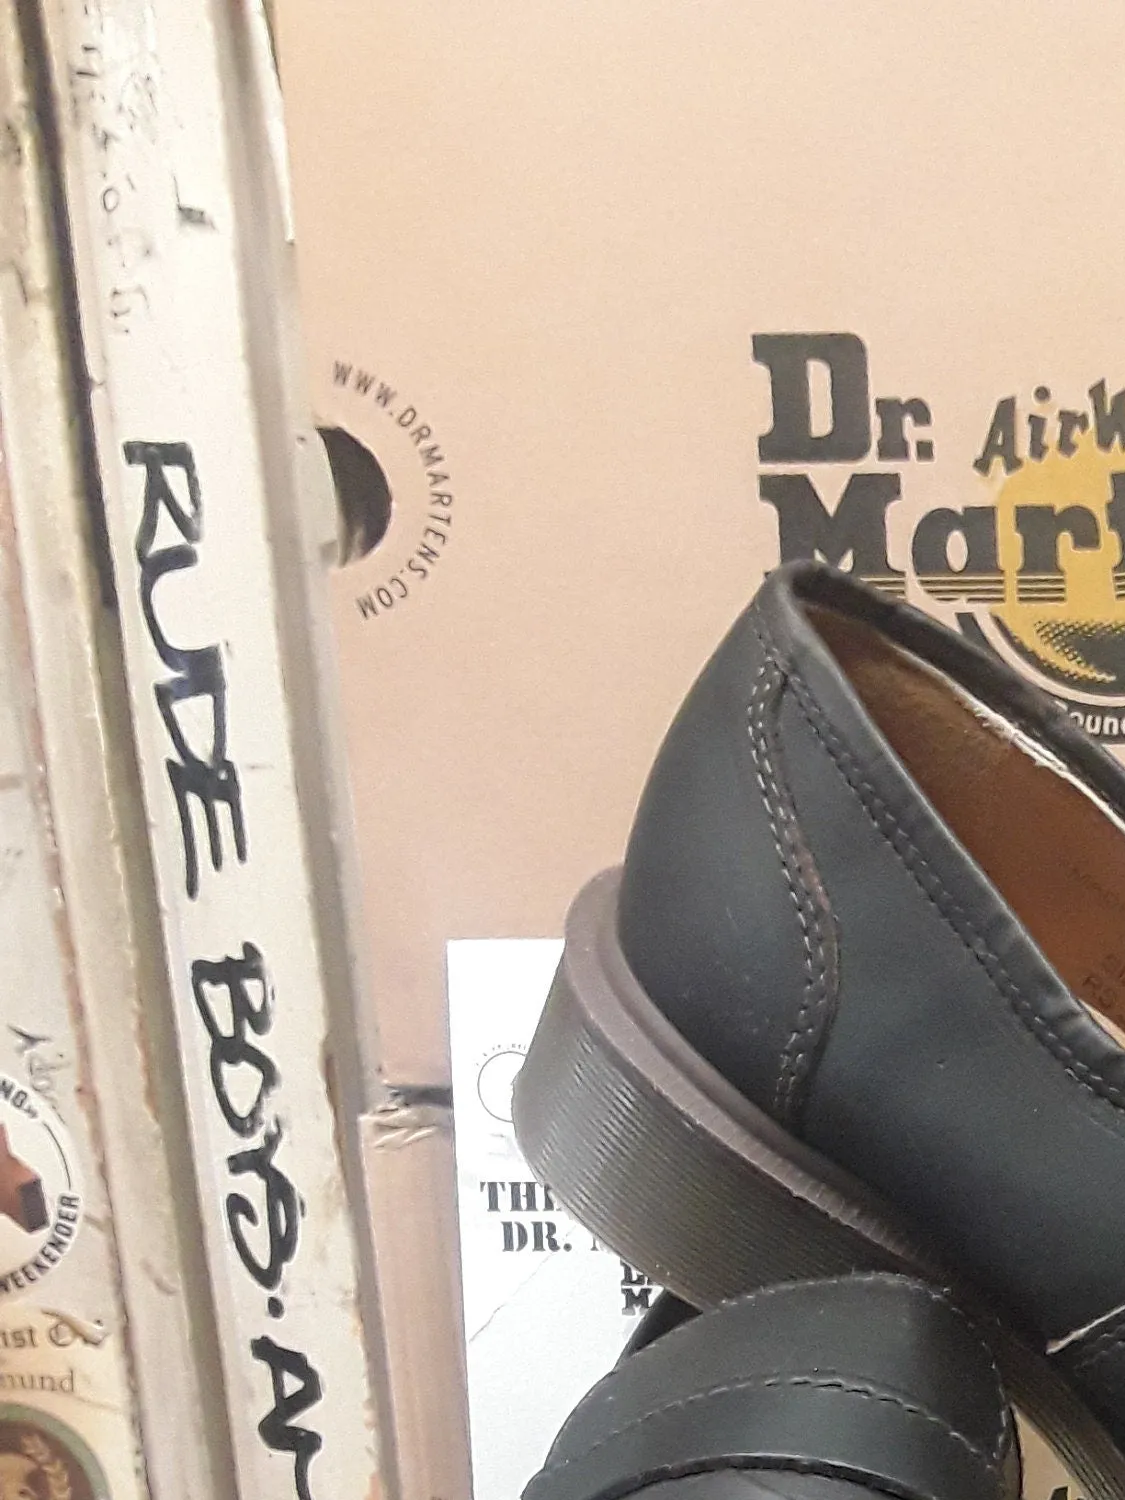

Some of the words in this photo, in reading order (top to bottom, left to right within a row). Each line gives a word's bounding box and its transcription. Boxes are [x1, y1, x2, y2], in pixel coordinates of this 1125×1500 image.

[752, 331, 935, 464] Dr.
[333, 360, 454, 621] WWW.DRMARTENS.COM
[501, 1220, 573, 1253] DR.
